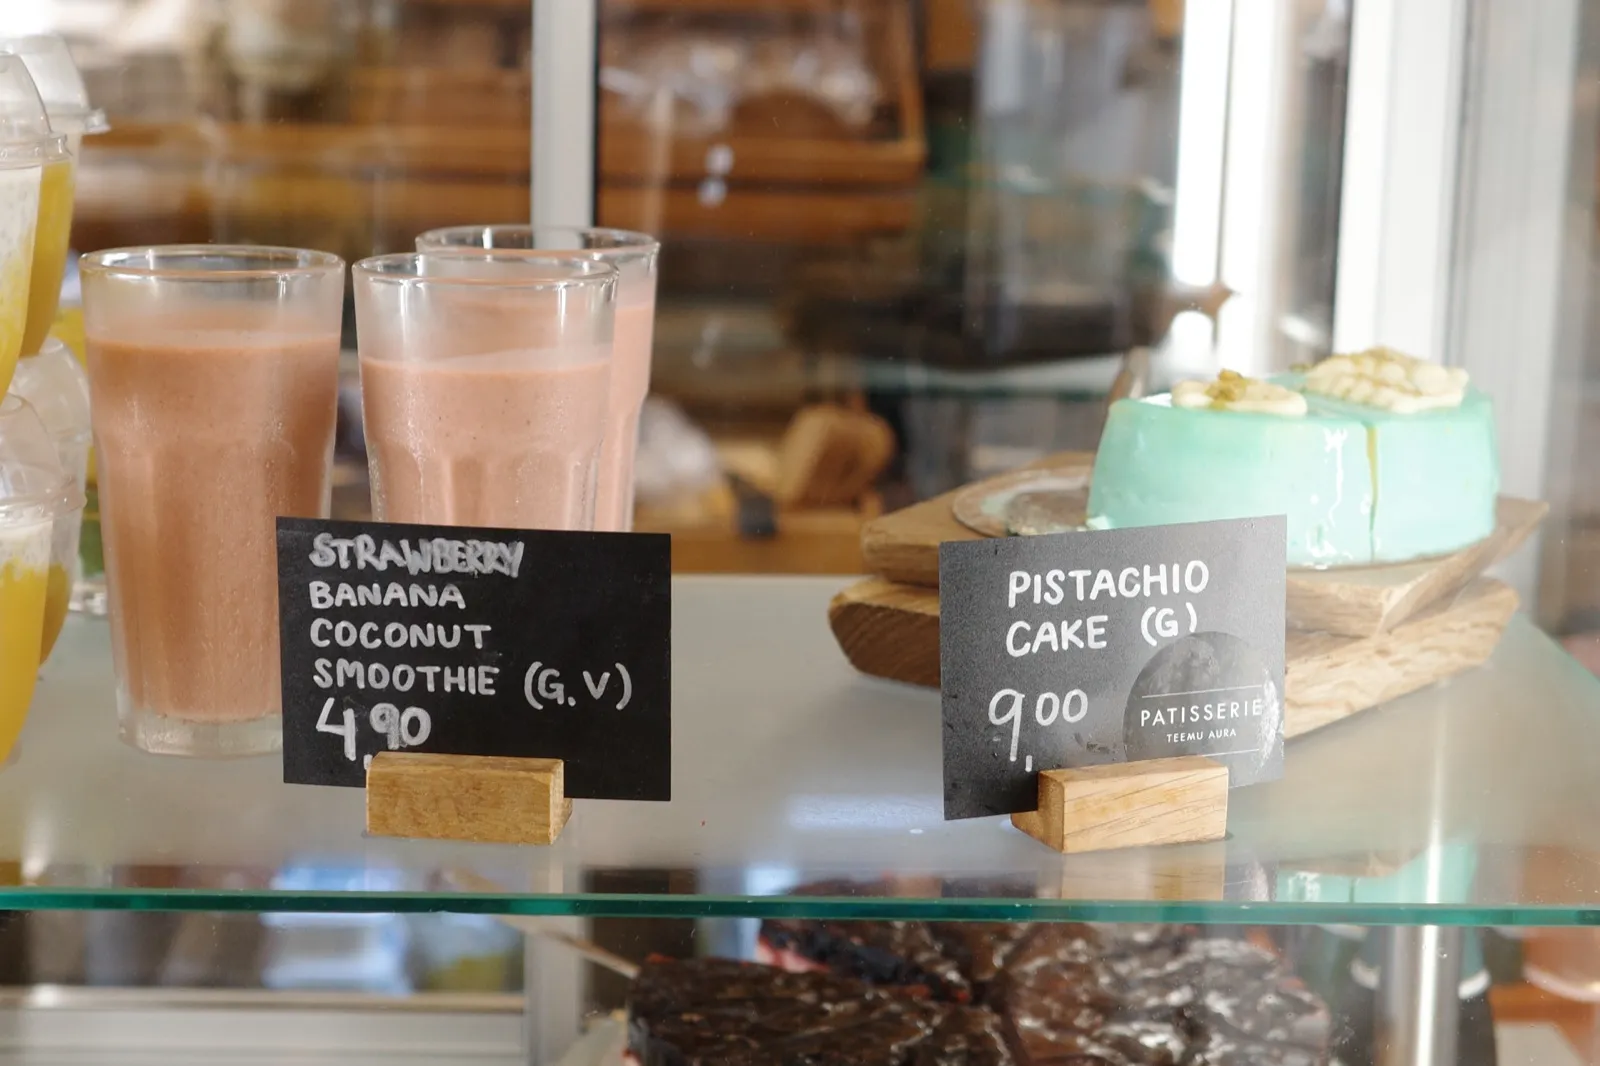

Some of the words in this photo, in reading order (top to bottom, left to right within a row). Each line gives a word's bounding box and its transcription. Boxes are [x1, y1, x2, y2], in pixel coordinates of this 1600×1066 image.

[308, 532, 525, 578] STRAWBERRY
[309, 581, 467, 610] BANANA
[1008, 560, 1210, 608] PISTACHIO
[310, 618, 492, 649] COCONUT
[1005, 614, 1109, 658] CAKE
[1140, 602, 1197, 647] (G)
[313, 657, 500, 696] SMOOTHIE
[1140, 698, 1264, 728] PATISSERIE
[1166, 730, 1204, 743] TEEMU
[1208, 728, 1237, 740] AURA
